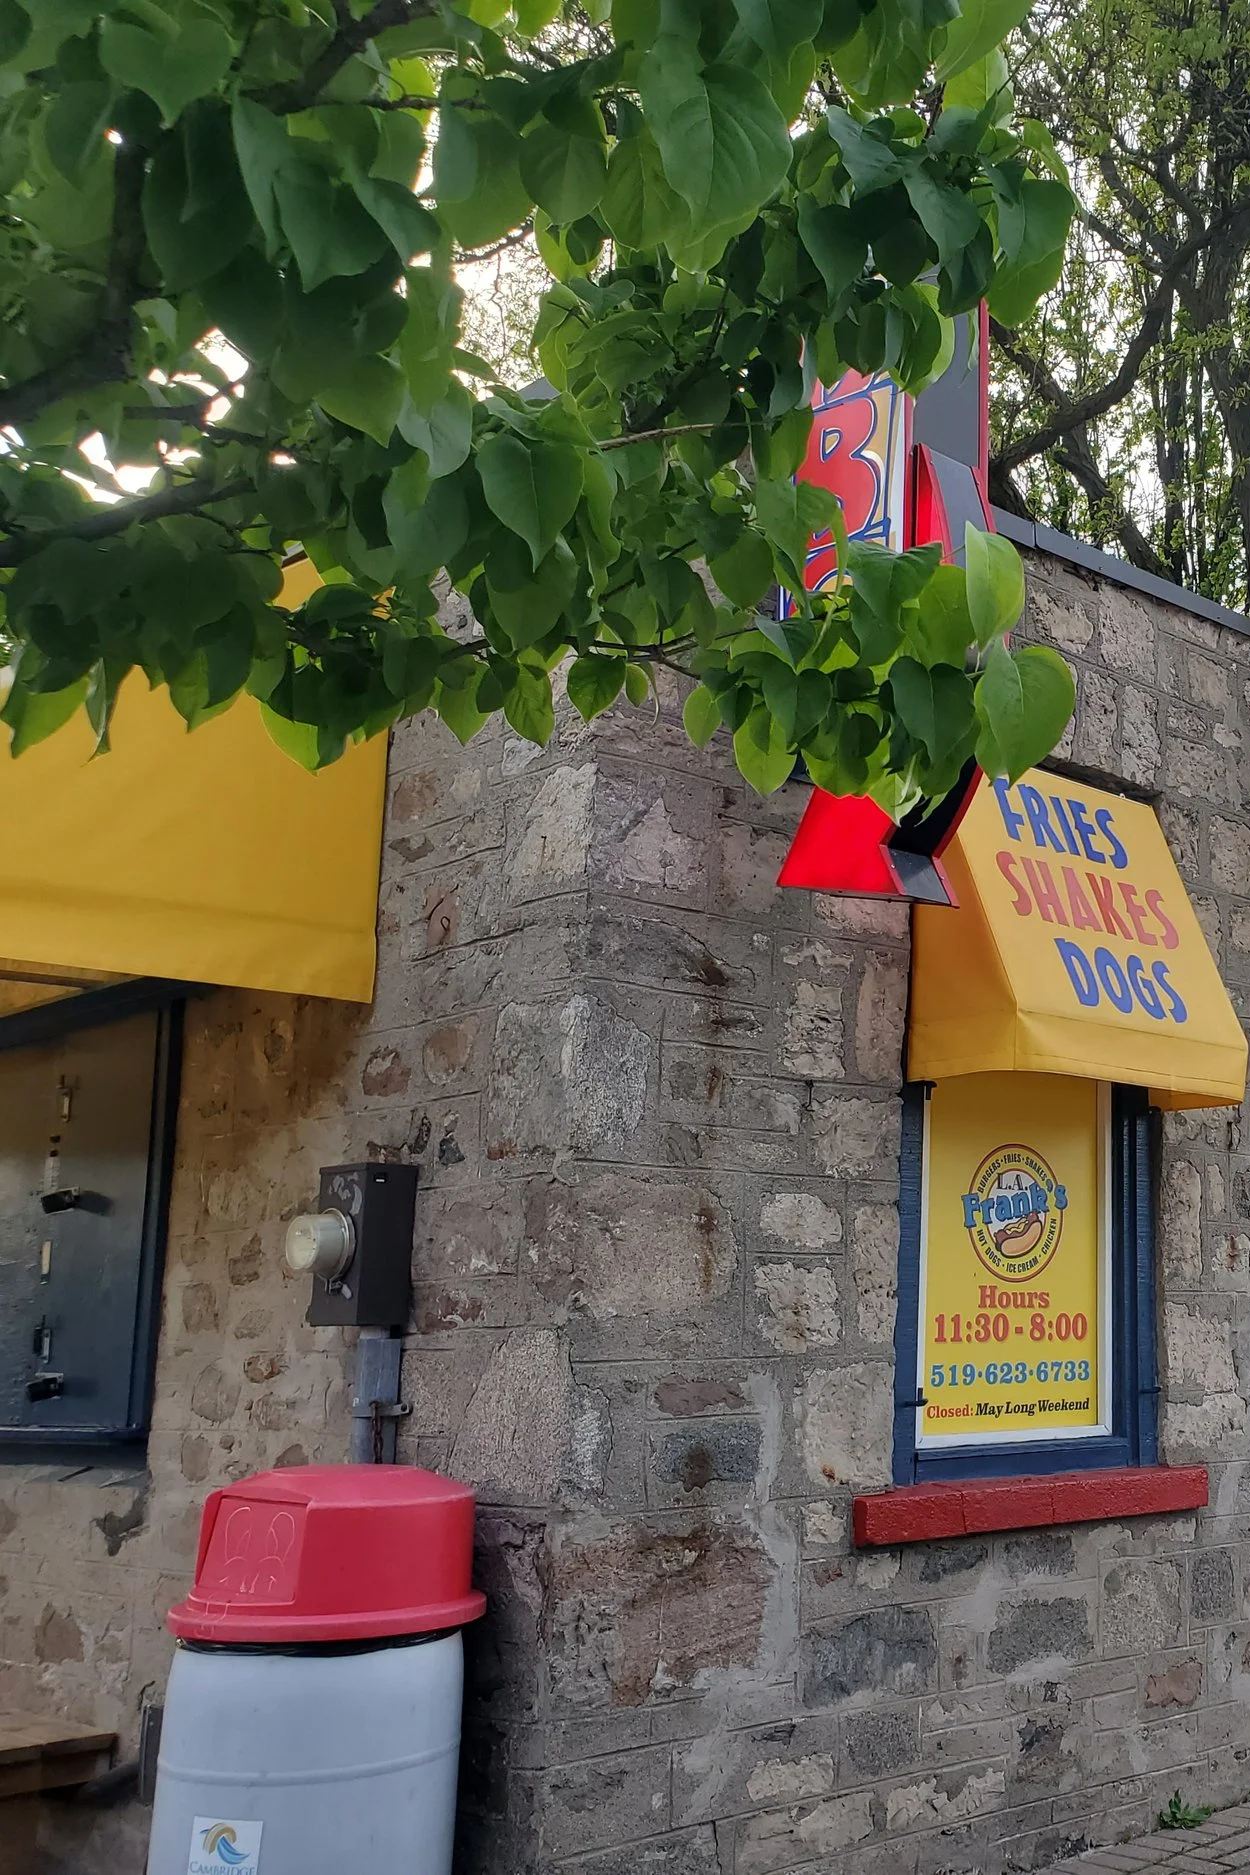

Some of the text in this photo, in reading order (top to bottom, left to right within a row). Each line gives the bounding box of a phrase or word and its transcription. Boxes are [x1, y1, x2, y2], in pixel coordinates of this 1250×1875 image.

[992, 777, 1128, 869] FRIES
[995, 851, 1180, 950] SHAKES
[1054, 937, 1188, 1024] DOGS
[977, 1153, 1048, 1194] BURGERS FRIES SHAKES
[996, 1172, 1029, 1191] L.A.
[961, 1178, 1069, 1229] Frank's
[976, 1218, 1057, 1273] HOT DOGS ICE CREAM CHICKEN
[977, 1285, 1050, 1309] Hours
[934, 1312, 1010, 1343] 11:30
[1029, 1312, 1088, 1342] 8:00
[926, 1397, 1090, 1419] Closed: May Long Weekend
